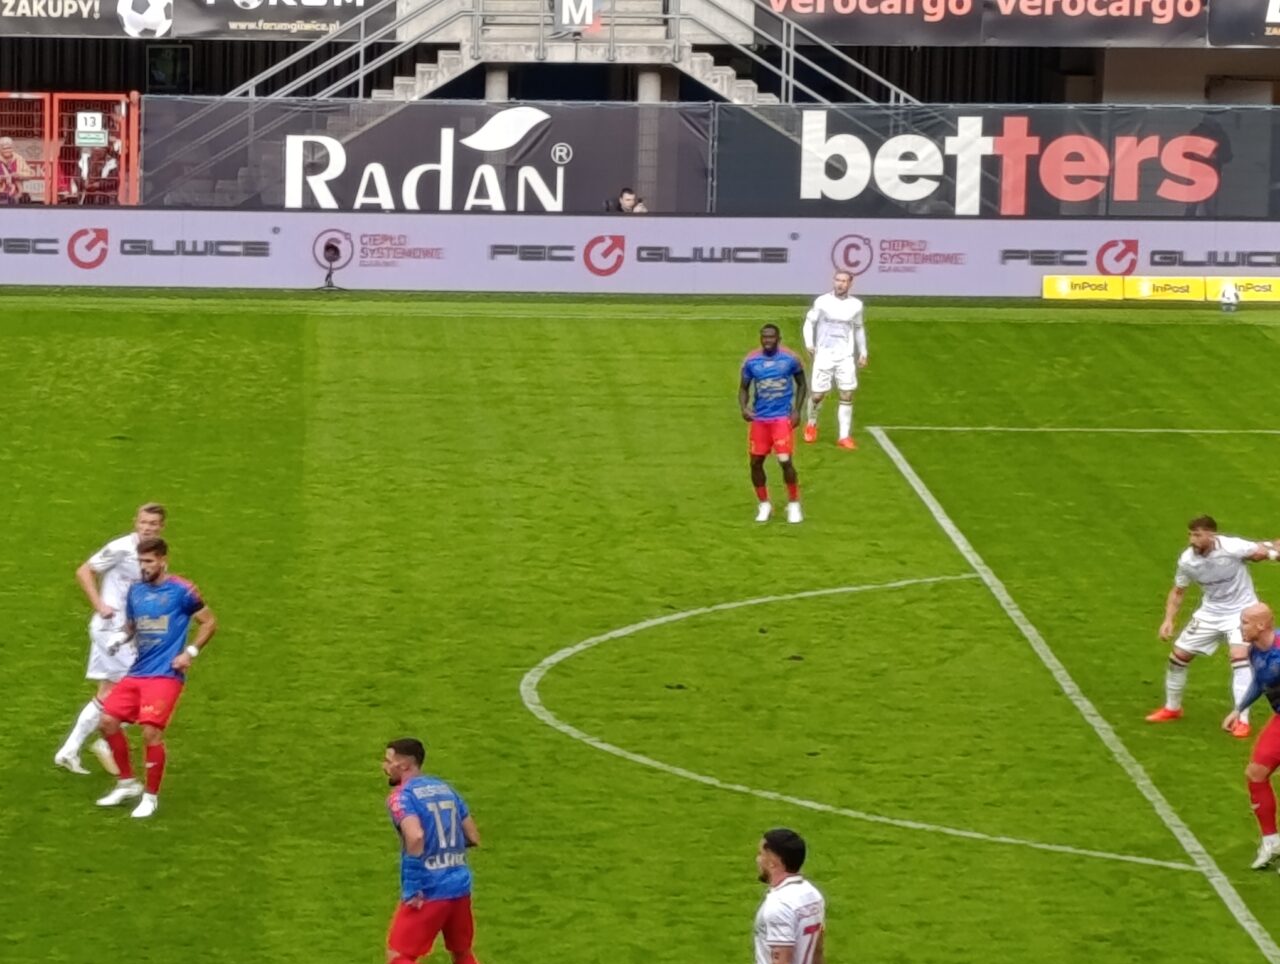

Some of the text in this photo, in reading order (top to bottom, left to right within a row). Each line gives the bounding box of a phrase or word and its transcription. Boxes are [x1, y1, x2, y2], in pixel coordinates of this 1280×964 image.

[2, 0, 100, 20] ZAKUPY!
[83, 116, 97, 127] 13
[799, 109, 1220, 216] betters
[1149, 249, 1280, 268] GLIWIC
[426, 800, 458, 849] 17
